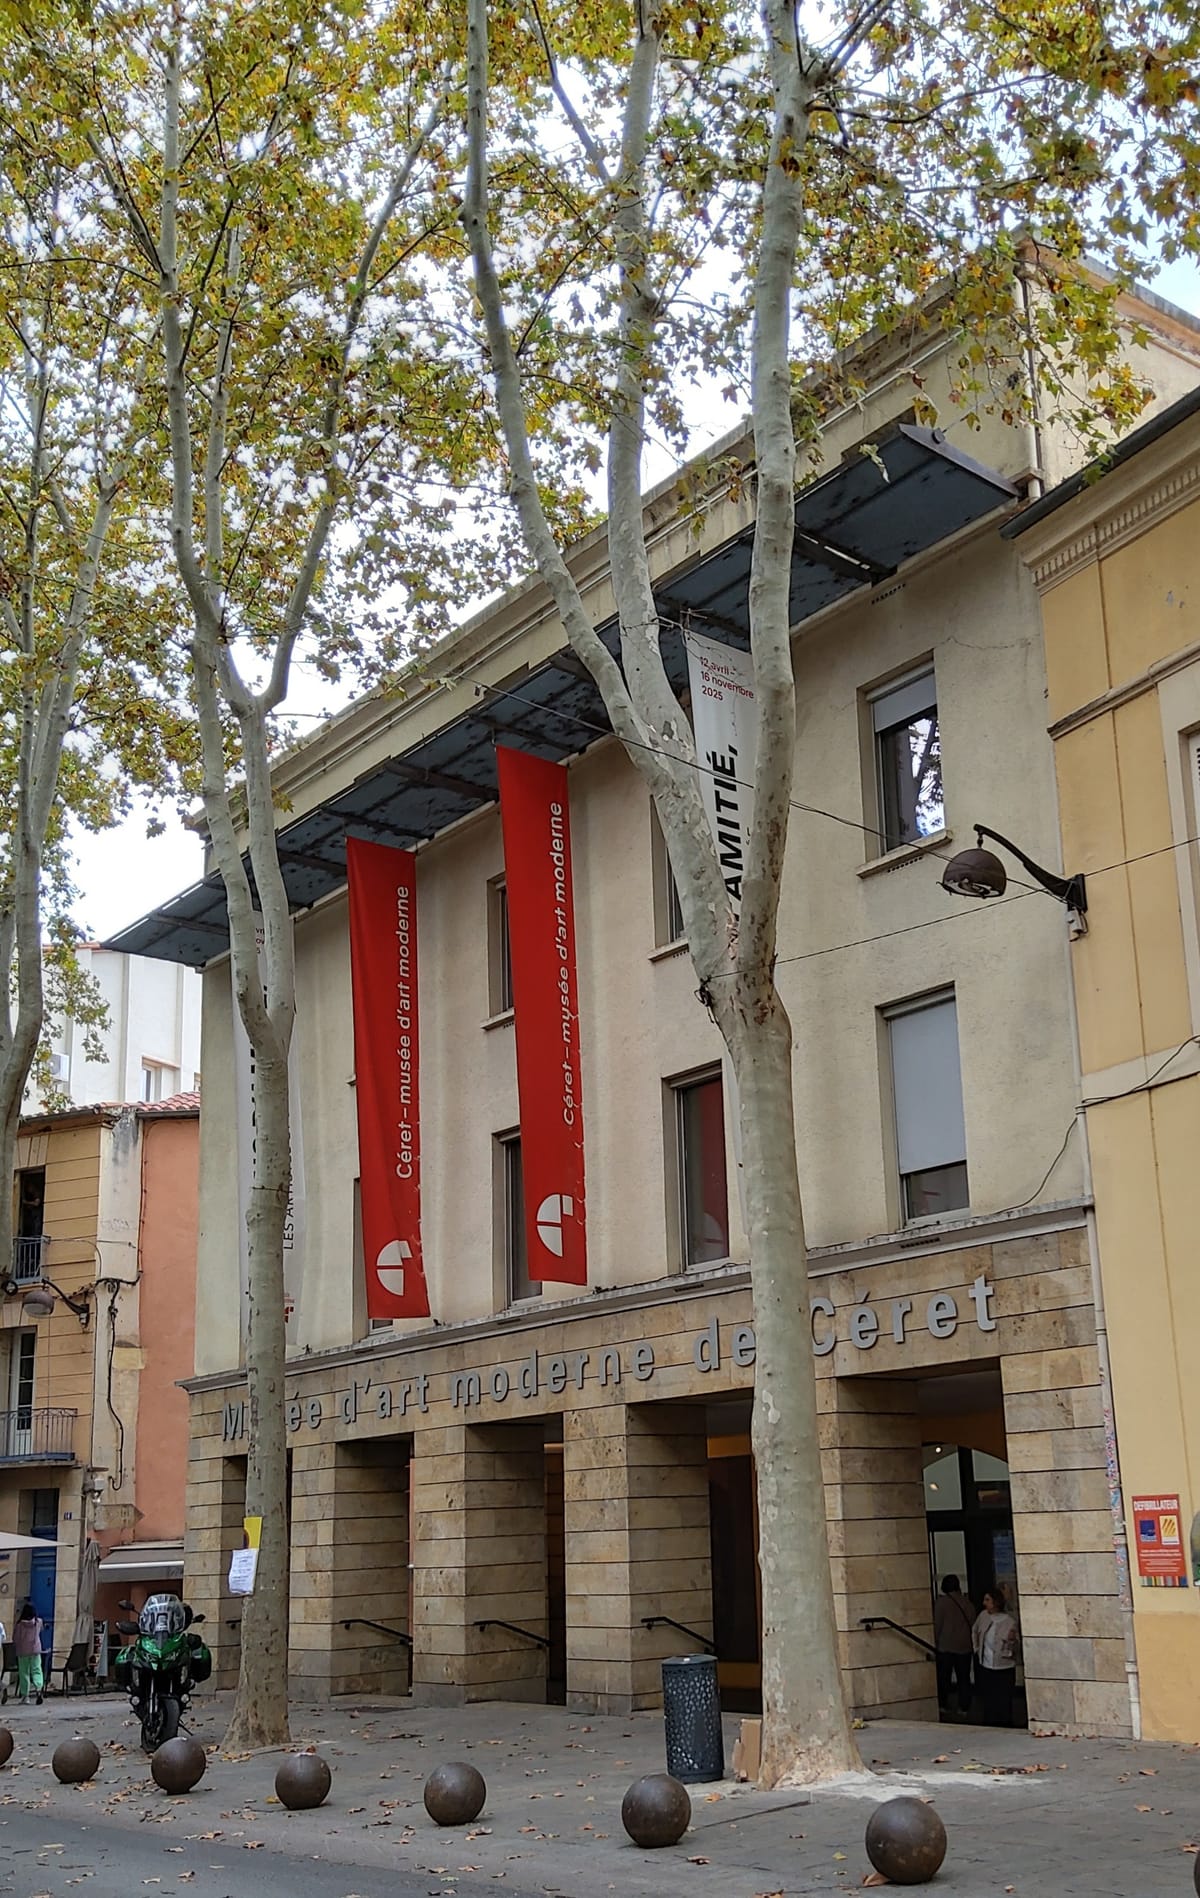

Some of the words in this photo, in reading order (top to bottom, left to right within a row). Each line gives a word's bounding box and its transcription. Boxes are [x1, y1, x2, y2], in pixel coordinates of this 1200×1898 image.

[701, 670, 711, 682] 16
[711, 676, 754, 699] novembre
[701, 685, 724, 701] 2025
[710, 662, 730, 675] avril
[550, 803, 566, 903] moderne
[395, 886, 410, 978] moderne
[558, 967, 571, 1043] musée
[396, 1033, 411, 1104] musée
[562, 1062, 574, 1126] Céret
[396, 1121, 412, 1179] Céret
[282, 1223, 294, 1250] LES
[221, 1391, 322, 1442] Mée
[451, 1341, 655, 1408] moderne
[693, 1316, 756, 1373] de
[810, 1274, 997, 1357] Céret
